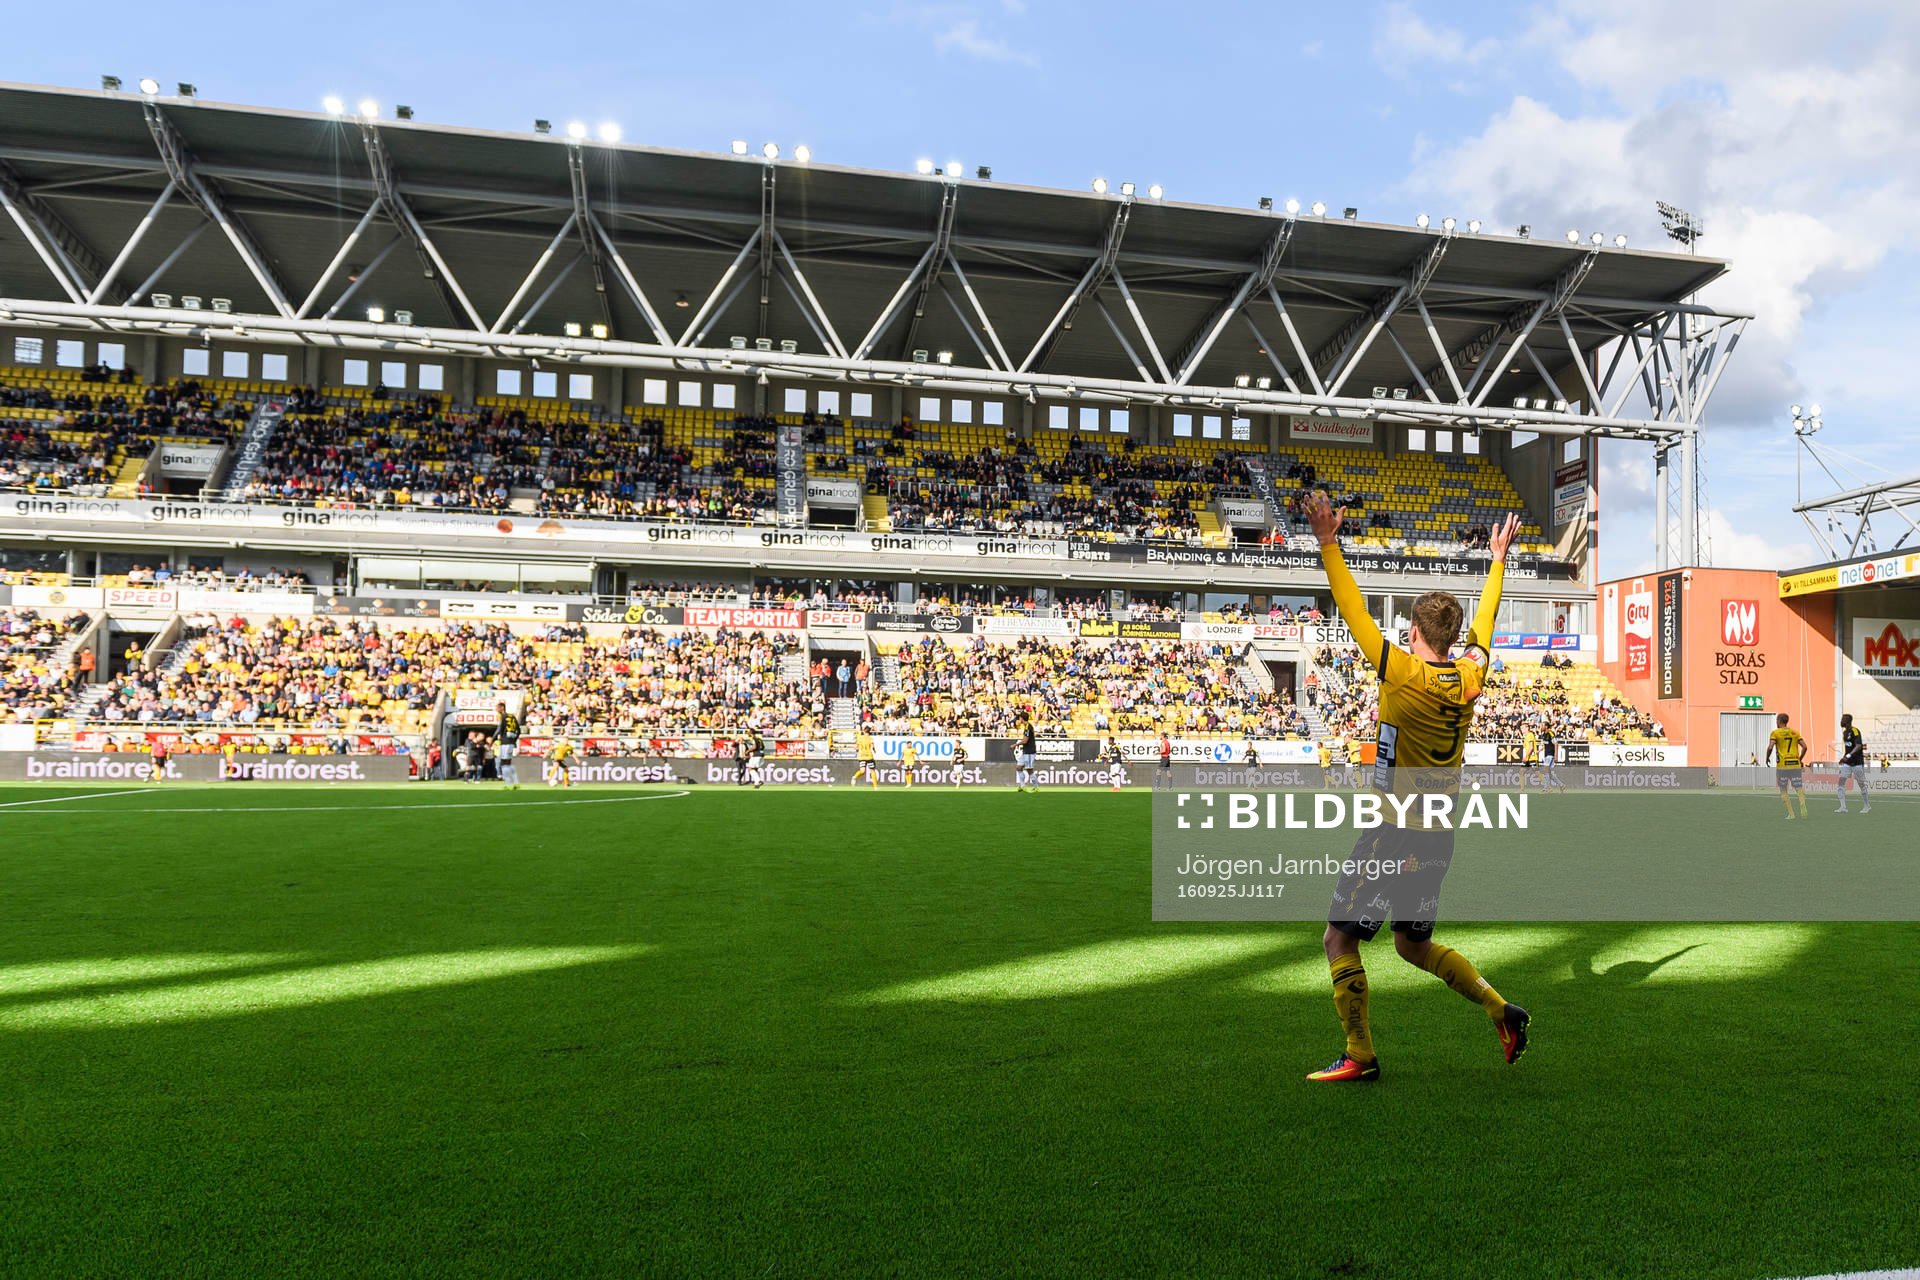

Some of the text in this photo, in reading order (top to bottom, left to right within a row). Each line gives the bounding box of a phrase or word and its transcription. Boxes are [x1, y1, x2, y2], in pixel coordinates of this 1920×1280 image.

[1311, 421, 1370, 436] Städkedjan
[162, 453, 219, 465] ginatrico
[808, 486, 858, 498] ginatricot
[15, 496, 121, 516] ginatricot
[152, 502, 252, 522] ginatricot
[282, 509, 381, 527] ginatricot
[648, 524, 736, 542] ginatricot
[760, 529, 846, 547] ginatricot
[871, 534, 953, 553] ginatricot
[977, 538, 1058, 557] ginatricot
[1073, 550, 1111, 561] SPORTS
[1216, 552, 1228, 563] &
[1382, 561, 1400, 571] ON
[1404, 562, 1425, 571] ALL
[1429, 563, 1469, 573] LEVELS
[1800, 574, 1837, 588] TILLSAMMANS
[111, 590, 172, 603] SPEED
[686, 608, 800, 628] TEAM SPORTIA
[811, 611, 862, 624] SPEED
[1254, 626, 1299, 637] SPEED
[1316, 628, 1387, 643] SERNE
[1864, 622, 1920, 668] MAX
[1630, 651, 1647, 666] 7-23
[1715, 648, 1766, 668] BORÅS
[1719, 670, 1759, 685] STAD
[461, 698, 505, 707] SPEE
[884, 740, 955, 761] upono
[1784, 737, 1793, 753] 7
[1625, 747, 1665, 763] eskils
[26, 756, 183, 779] brainforet.
[707, 762, 836, 784] branforest.
[1585, 769, 1680, 788] brainforest.
